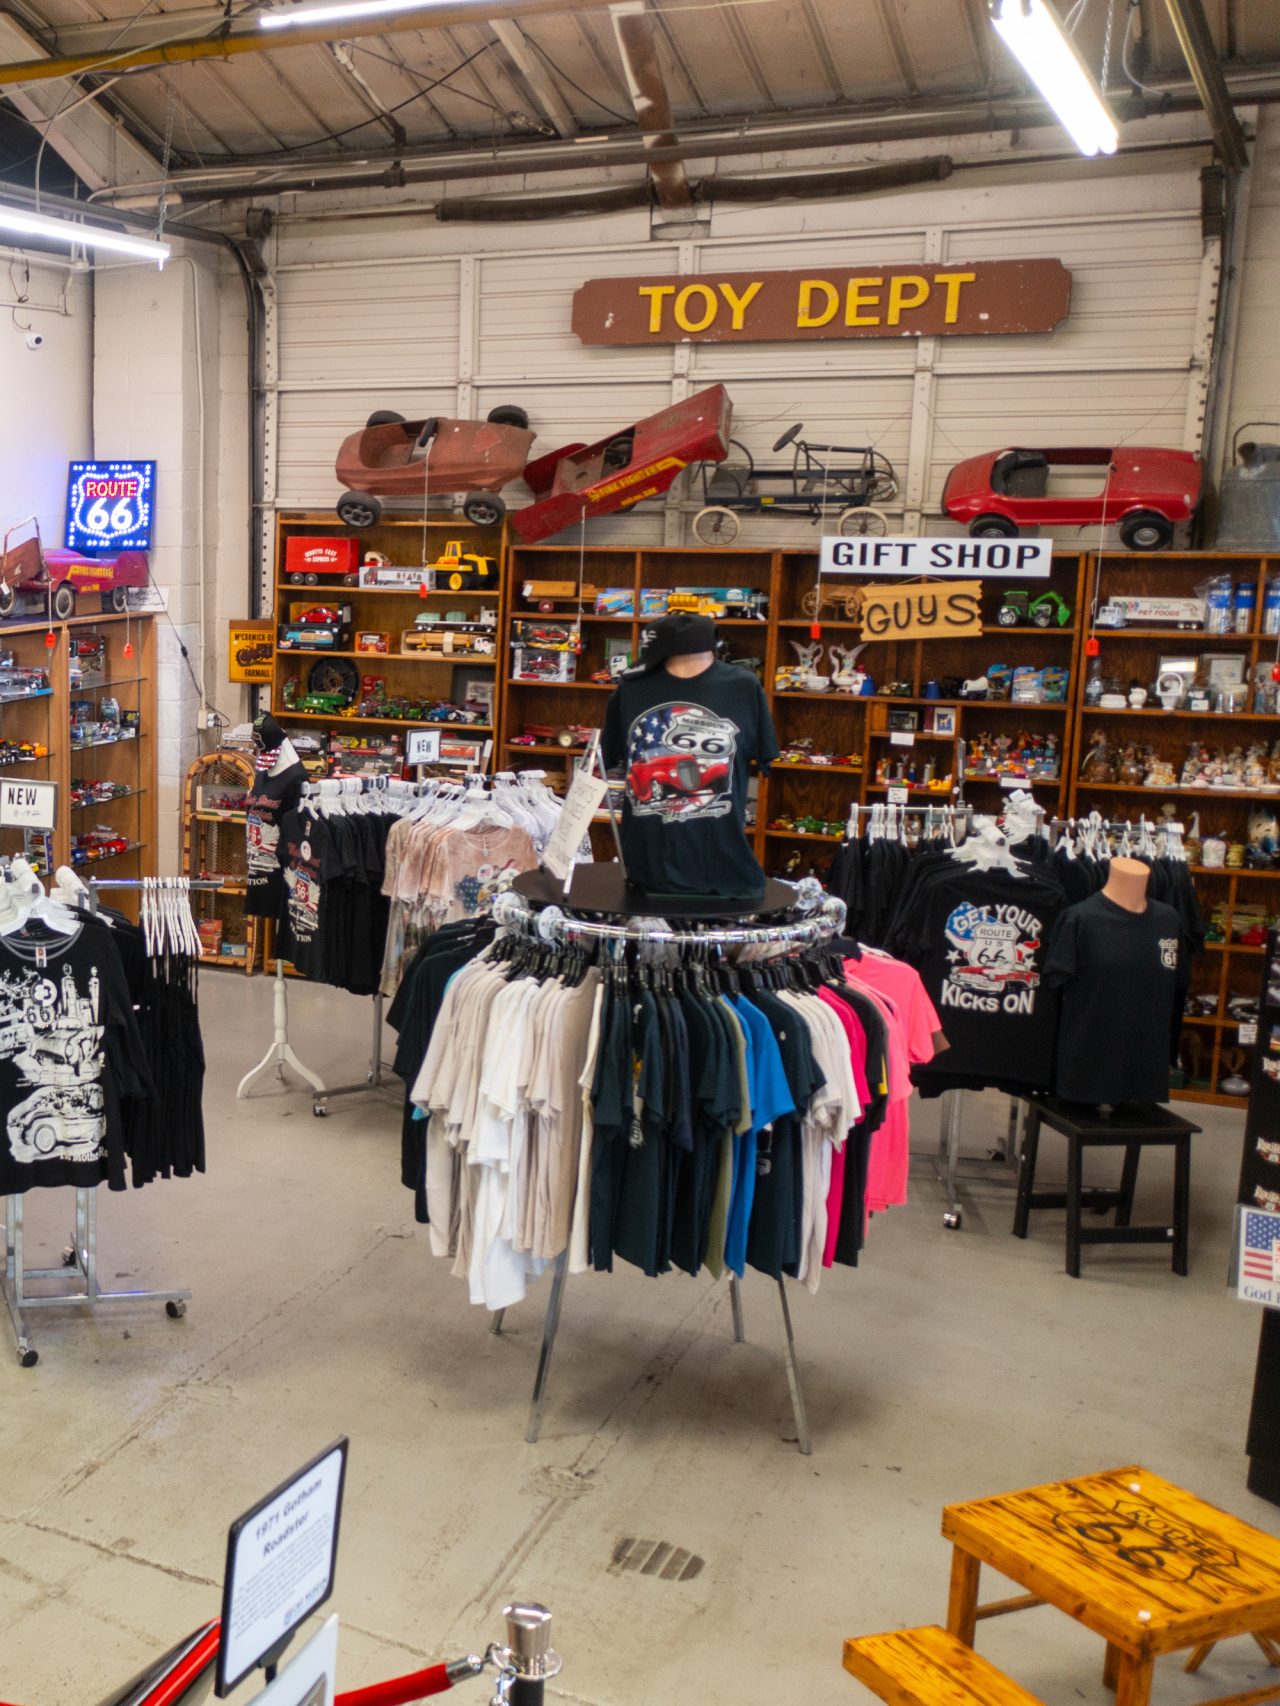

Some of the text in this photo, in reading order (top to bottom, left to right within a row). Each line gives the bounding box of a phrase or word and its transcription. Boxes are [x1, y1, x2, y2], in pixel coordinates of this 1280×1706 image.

[639, 272, 976, 333] TOY DEPT
[86, 480, 137, 497] ROUTE
[86, 496, 133, 531] 66
[832, 541, 1041, 569] GIFT SHOP
[866, 593, 977, 635] GUYS
[245, 669, 270, 677] FARMALL
[681, 717, 729, 731] MISSOURI
[417, 740, 432, 753] NEW
[671, 733, 725, 754] 66
[8, 787, 37, 805] NEW
[952, 904, 1043, 939] GET YOUR
[980, 928, 1013, 938] ROUTE
[977, 947, 1007, 966] 66
[941, 978, 1036, 1015] KICKS ON
[27, 1006, 51, 1023] 66
[1244, 1284, 1271, 1301] God
[256, 1478, 323, 1540] 1971 Gotham
[263, 1510, 310, 1557] Roadster
[1076, 1521, 1166, 1570] 66
[1128, 1509, 1220, 1562] ROUTE
